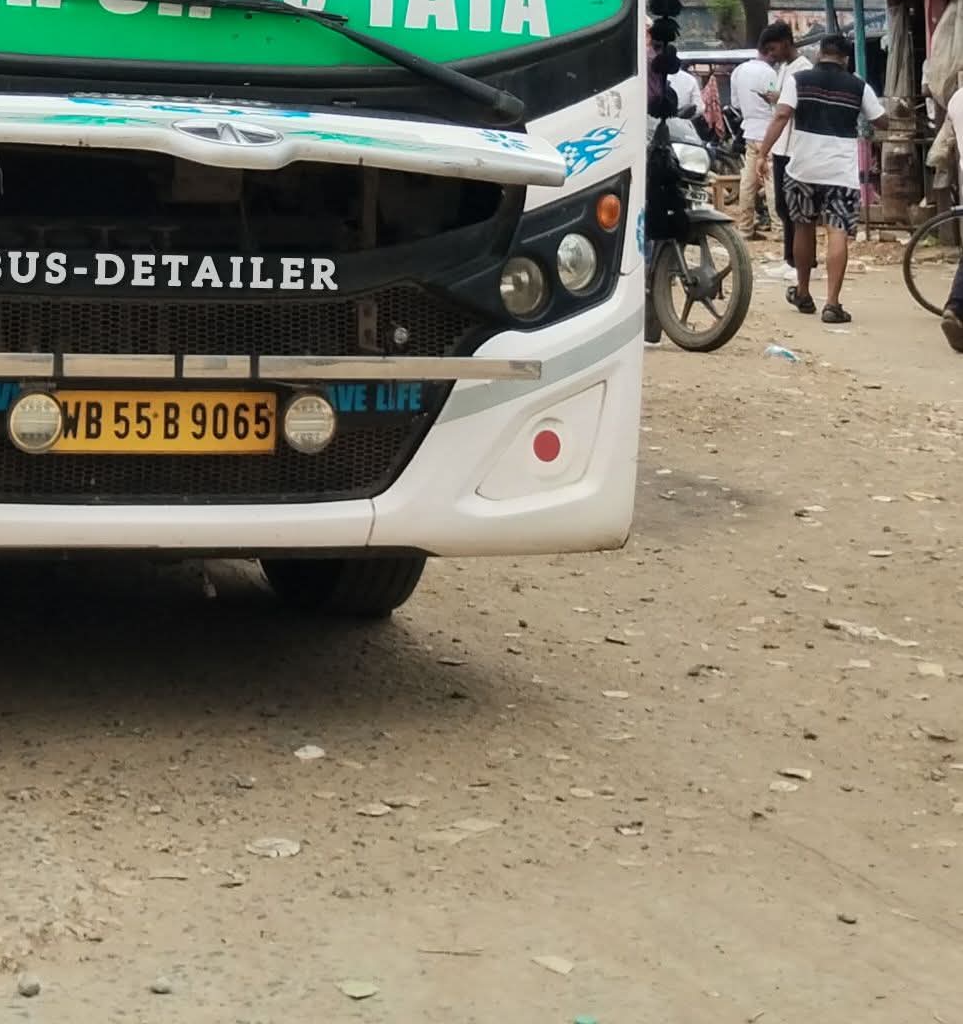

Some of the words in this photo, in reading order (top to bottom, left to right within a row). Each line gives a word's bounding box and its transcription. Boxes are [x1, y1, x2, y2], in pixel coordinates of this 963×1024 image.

[376, 383, 422, 411] LIFE
[61, 400, 102, 440] WB
[113, 401, 152, 440] 55
[163, 401, 181, 440] B
[190, 401, 273, 440] 9065
